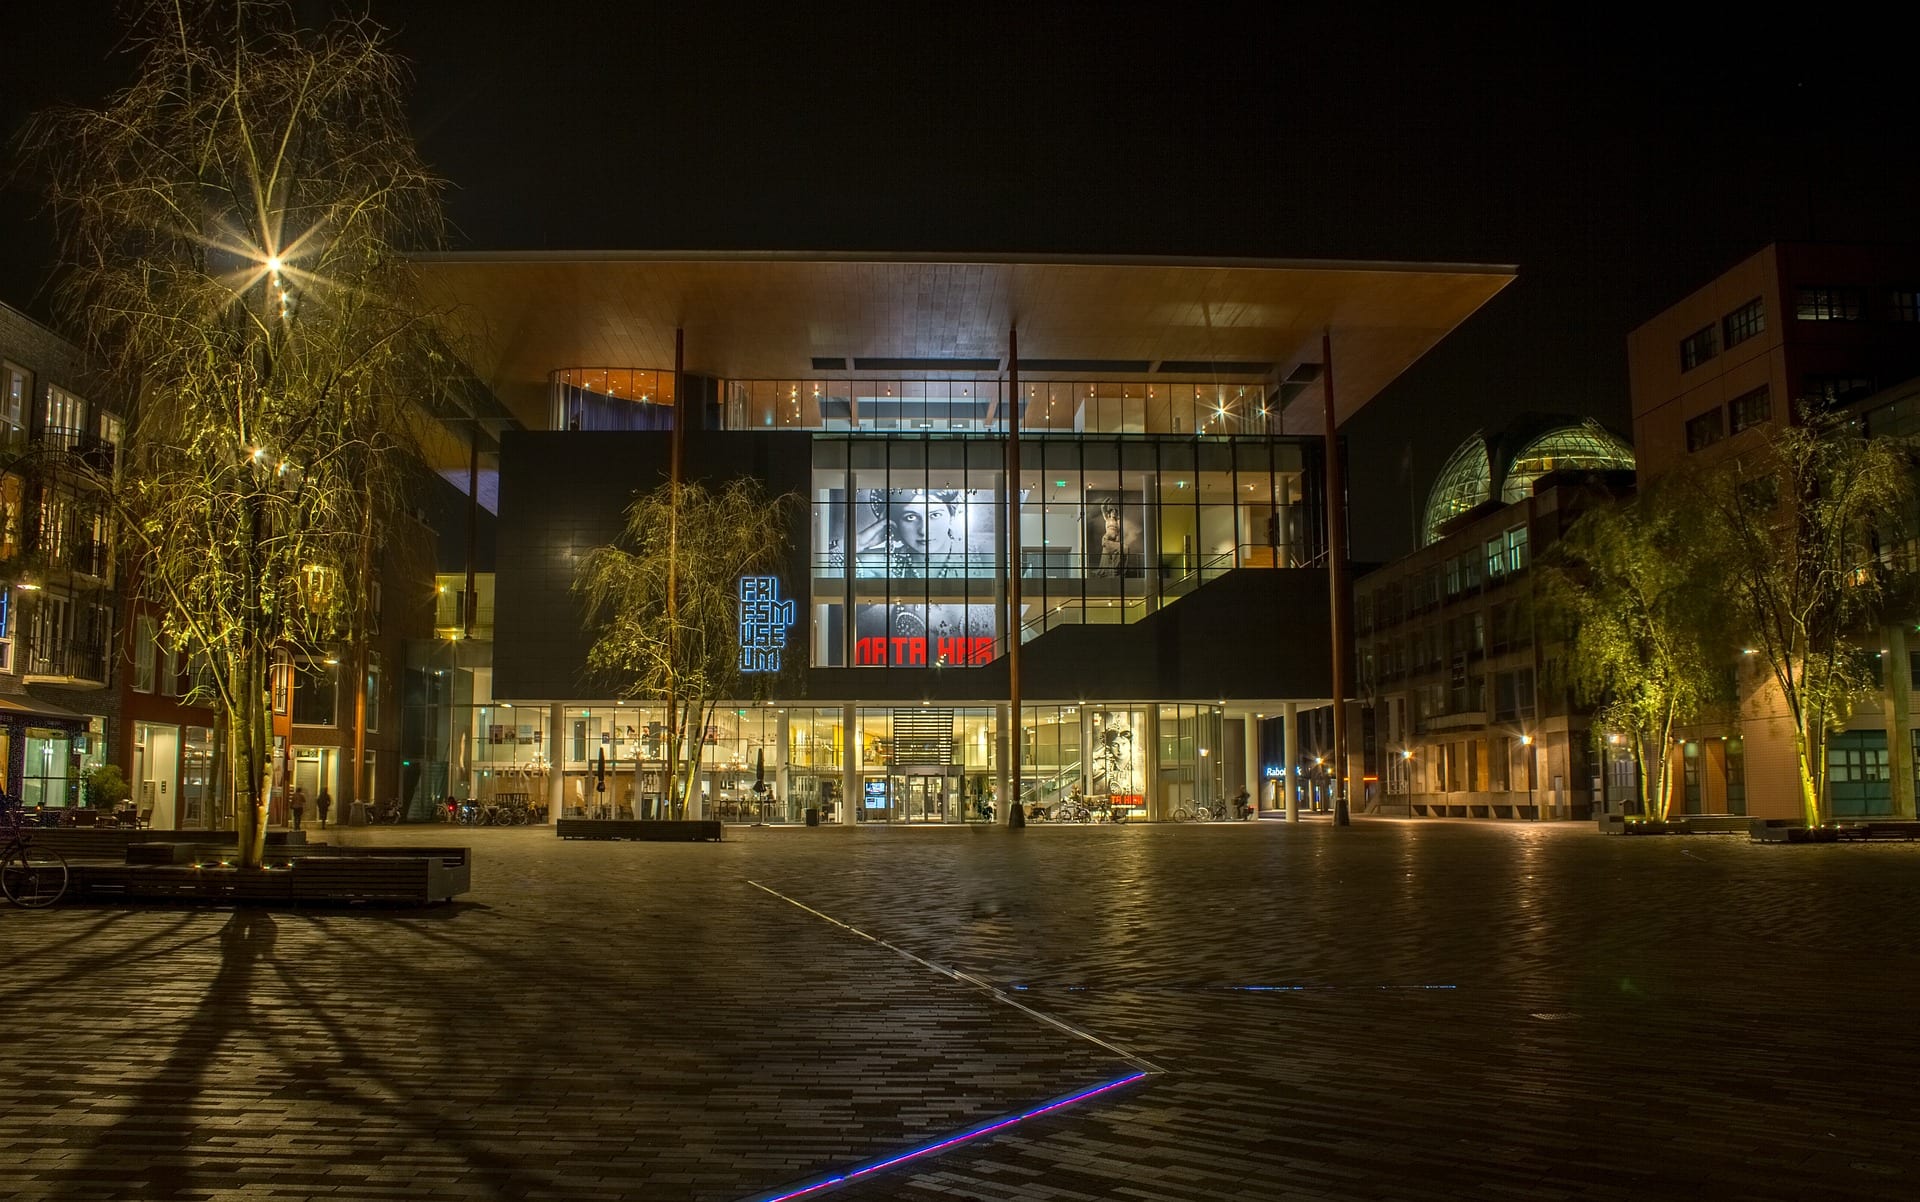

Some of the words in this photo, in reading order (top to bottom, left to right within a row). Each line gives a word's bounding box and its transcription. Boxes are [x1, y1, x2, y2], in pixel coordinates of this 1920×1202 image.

[740, 576, 777, 602] FRI
[740, 600, 794, 625] ESM
[740, 623, 785, 648] USE
[740, 646, 780, 672] UM
[1266, 765, 1302, 776] Rabok
